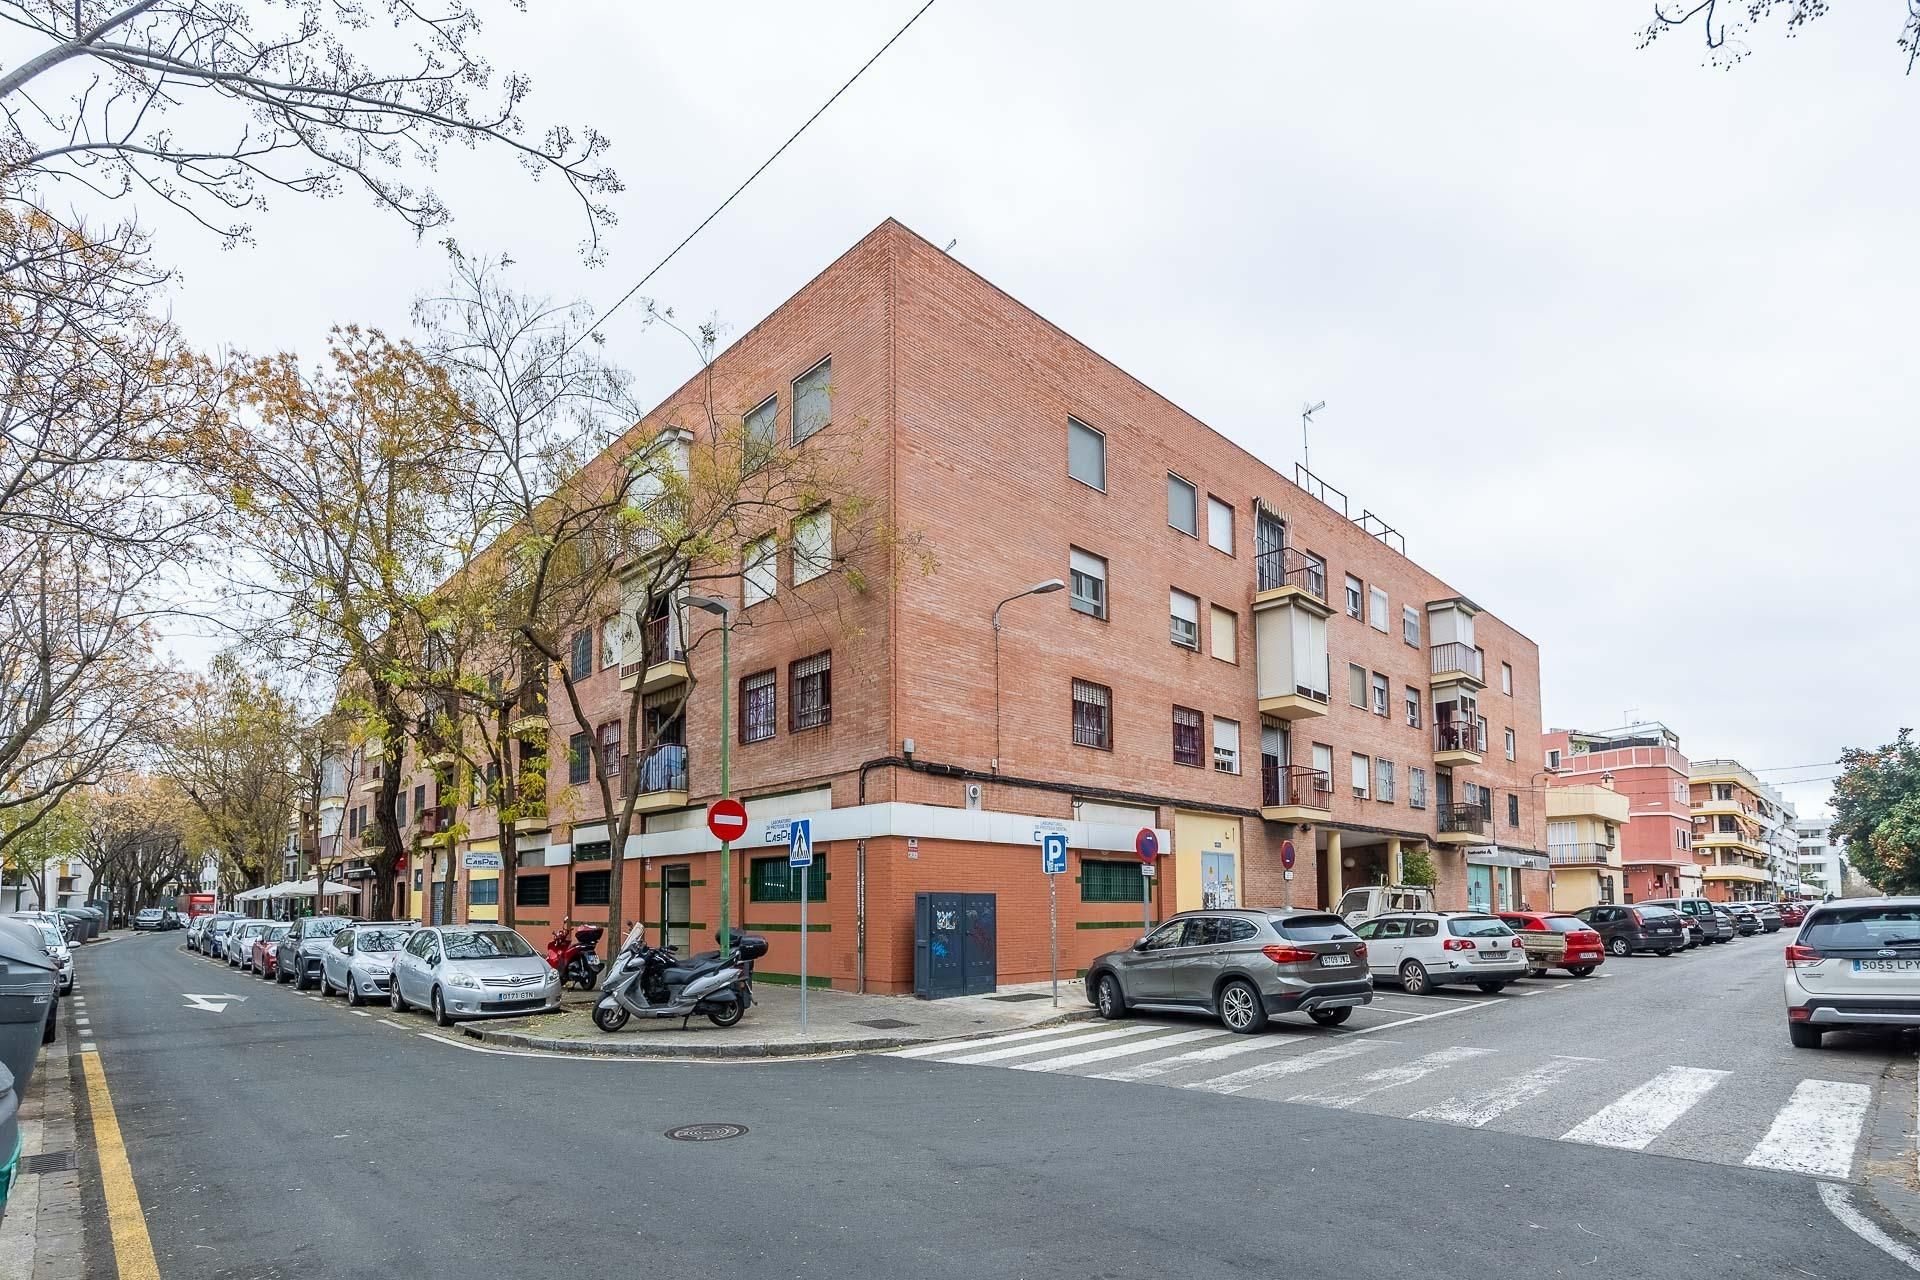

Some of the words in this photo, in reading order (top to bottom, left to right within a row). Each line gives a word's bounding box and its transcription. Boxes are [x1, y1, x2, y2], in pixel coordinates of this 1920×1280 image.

[1048, 839, 1062, 861] P
[1862, 960, 1893, 970] 5055
[502, 992, 518, 1000] 0171
